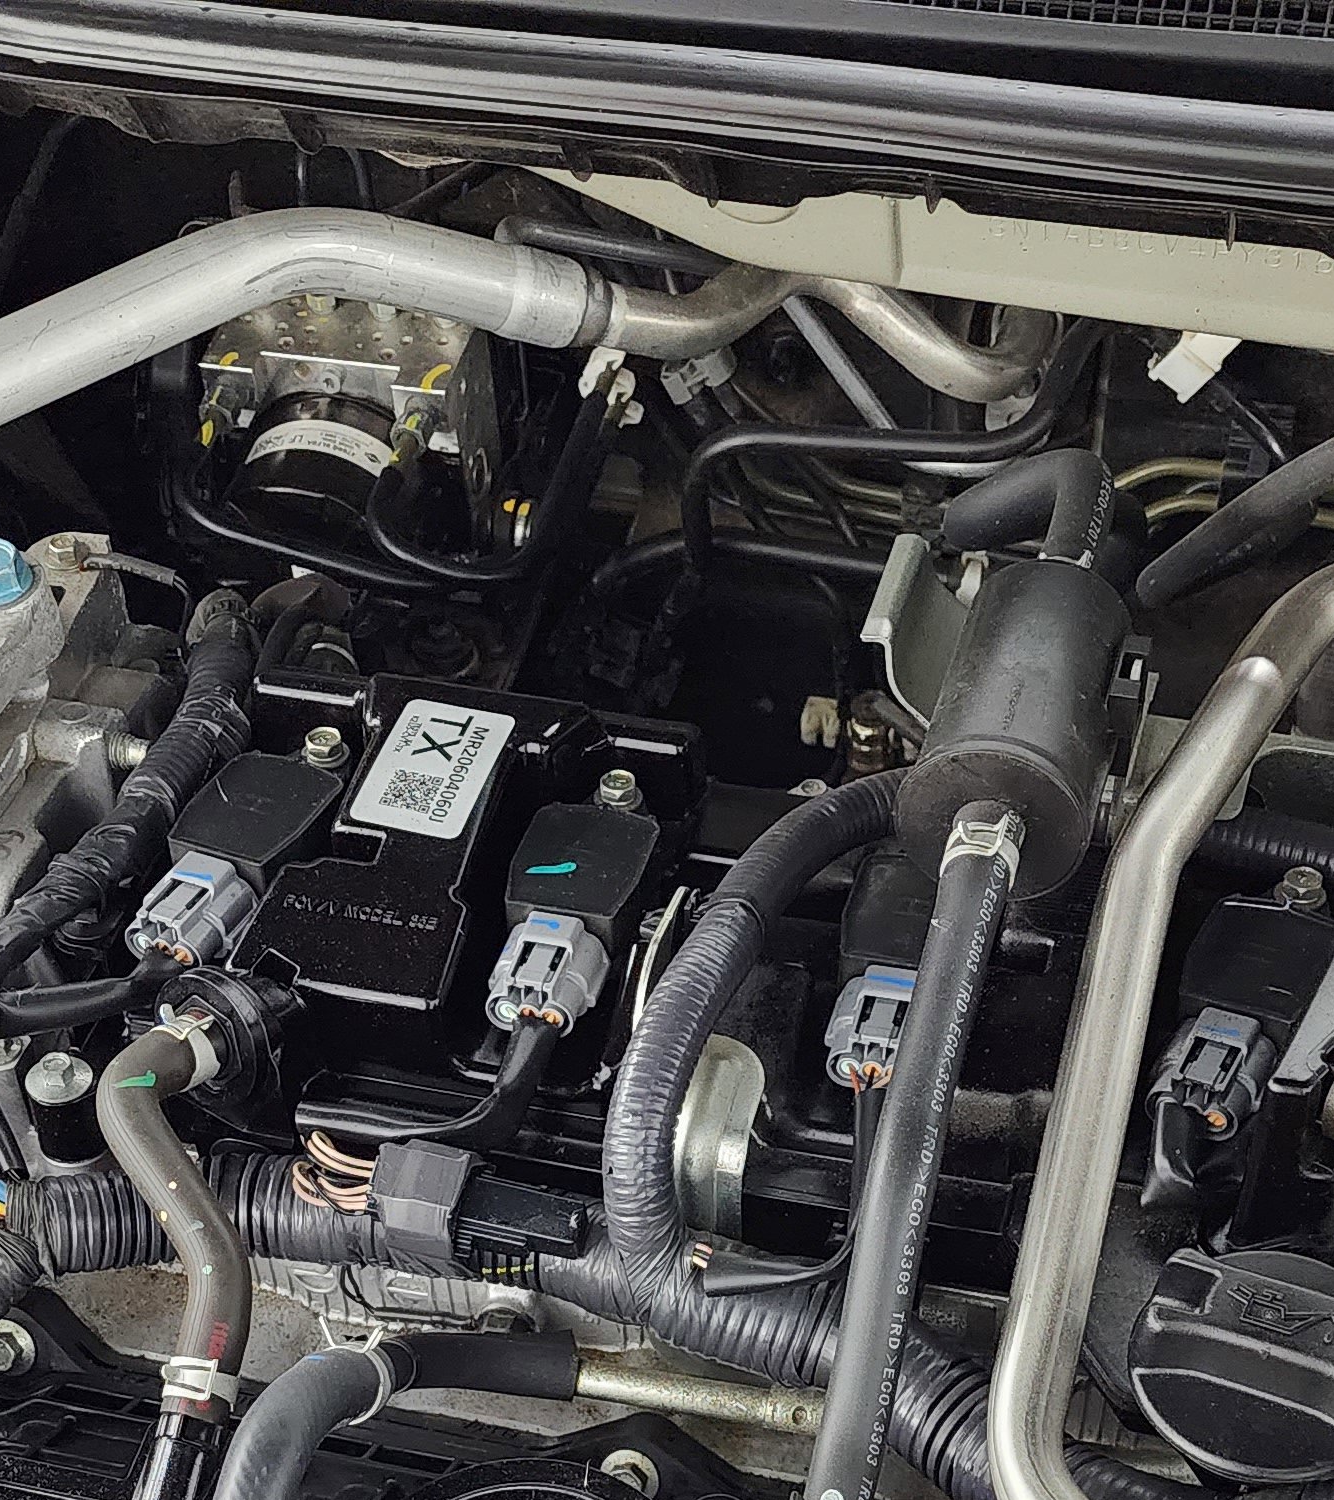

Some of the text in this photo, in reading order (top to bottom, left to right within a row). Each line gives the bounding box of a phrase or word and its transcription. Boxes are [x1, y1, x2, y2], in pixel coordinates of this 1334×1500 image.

[411, 716, 474, 762] TX
[428, 725, 489, 823] MR20604060J
[964, 856, 1007, 972] RD>ECO<3303
